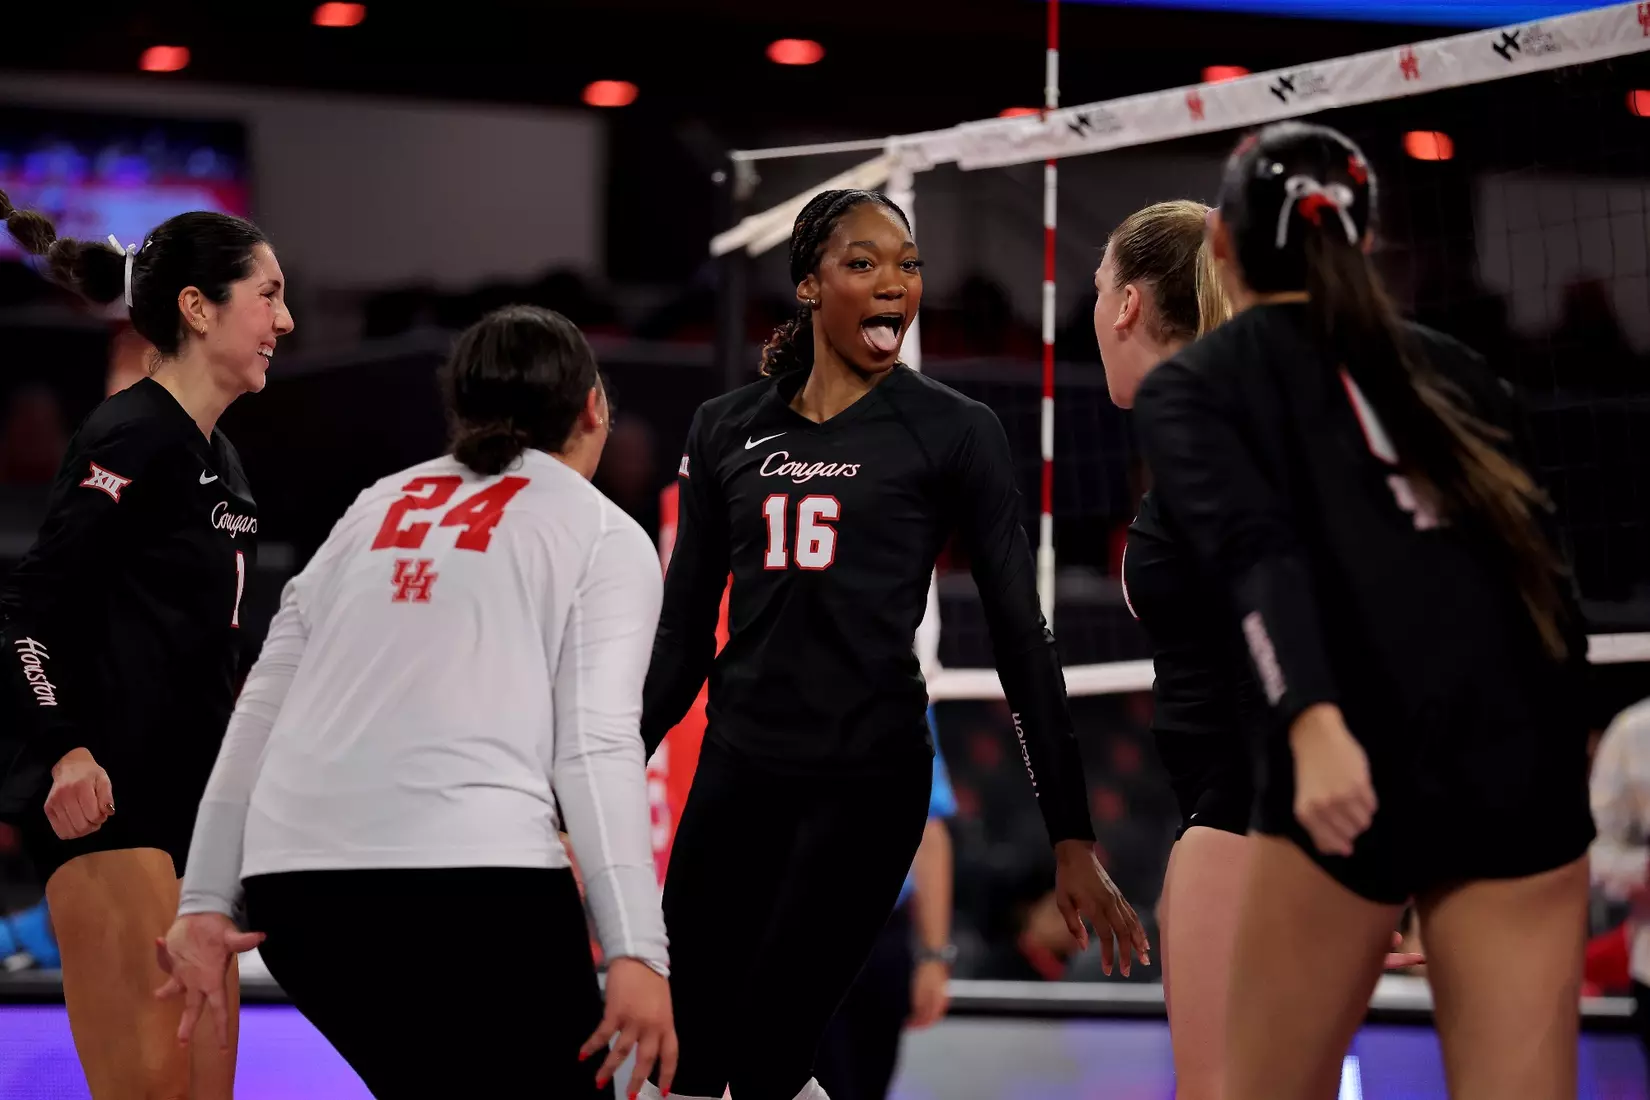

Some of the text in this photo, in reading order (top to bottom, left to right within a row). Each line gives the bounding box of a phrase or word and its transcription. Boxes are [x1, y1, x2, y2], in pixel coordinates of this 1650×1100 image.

[81, 461, 132, 503] XII
[759, 450, 861, 484] Cougars
[211, 501, 258, 539] Cougars
[370, 475, 531, 553] 24
[762, 493, 842, 571] 16
[14, 636, 58, 706] Houston
